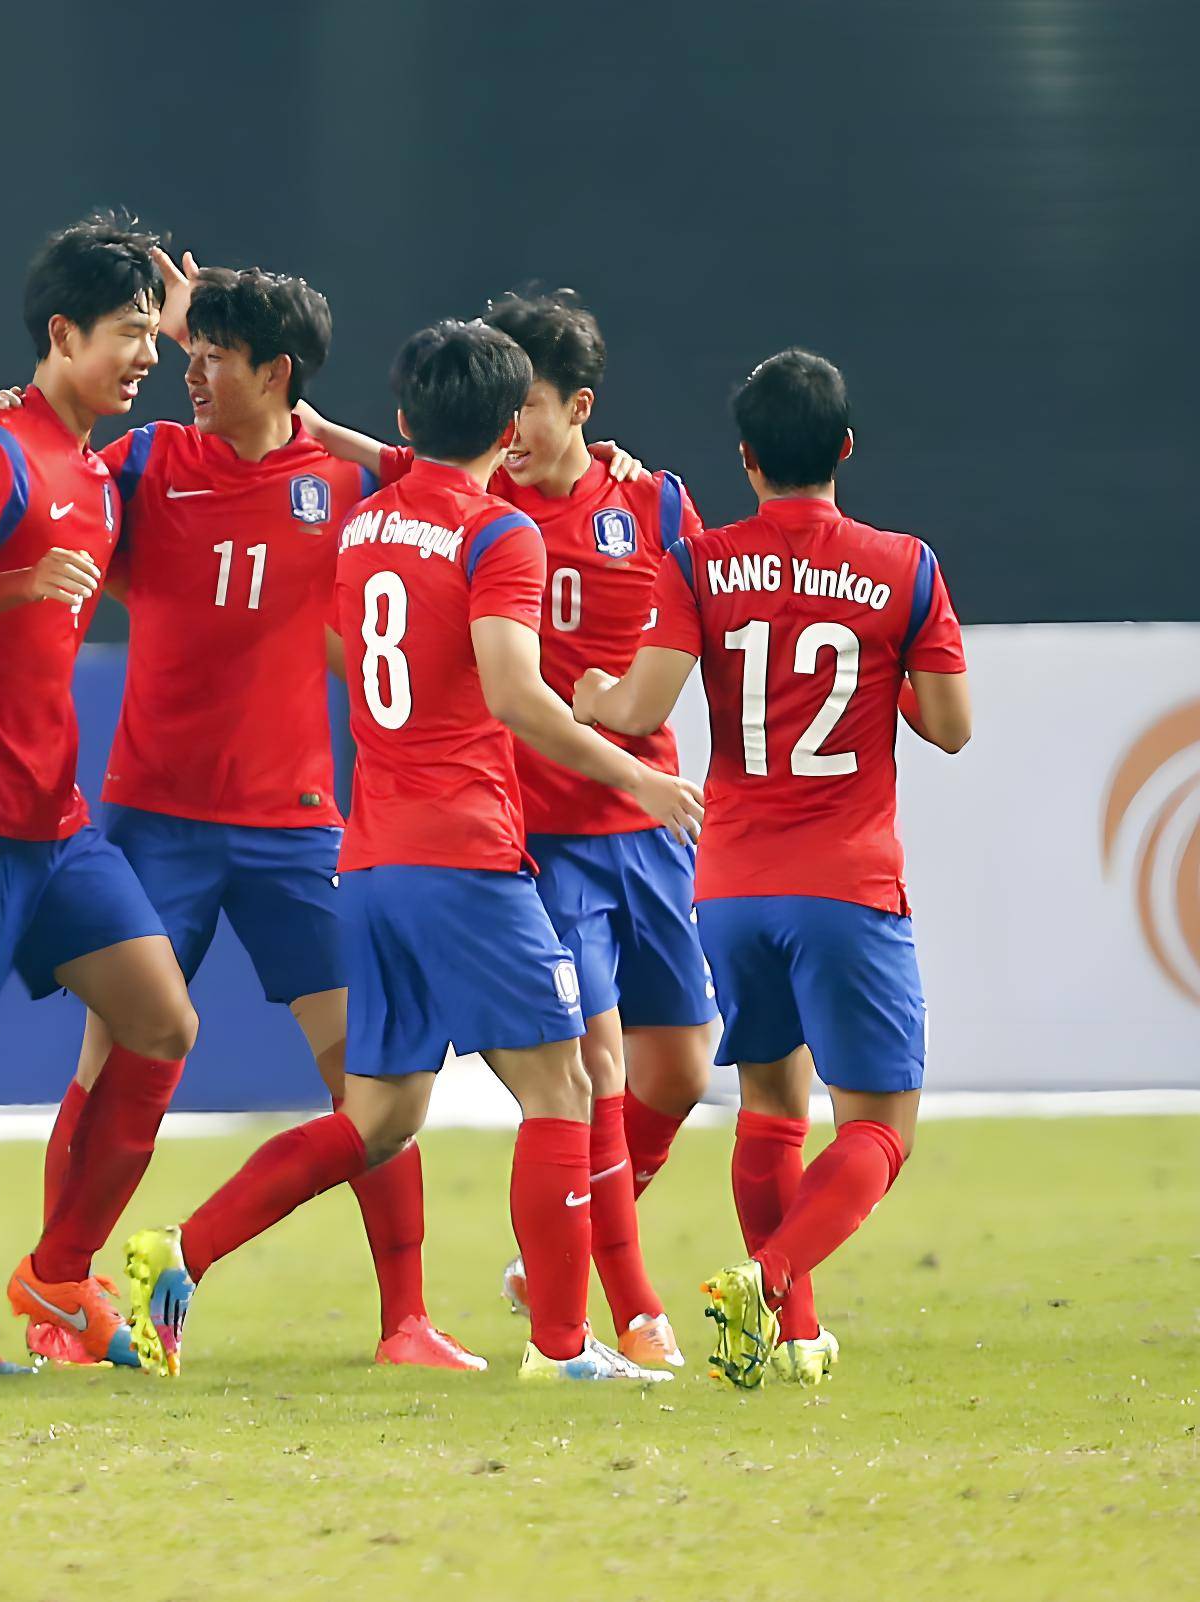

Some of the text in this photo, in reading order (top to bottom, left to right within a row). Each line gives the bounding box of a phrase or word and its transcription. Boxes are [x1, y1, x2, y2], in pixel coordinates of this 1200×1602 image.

[380, 510, 465, 563] Gwanguk
[213, 540, 267, 610] 11
[551, 566, 581, 632] 0
[707, 553, 891, 610] KANG Yunkoo
[361, 570, 412, 730] 8
[724, 619, 860, 777] 12
